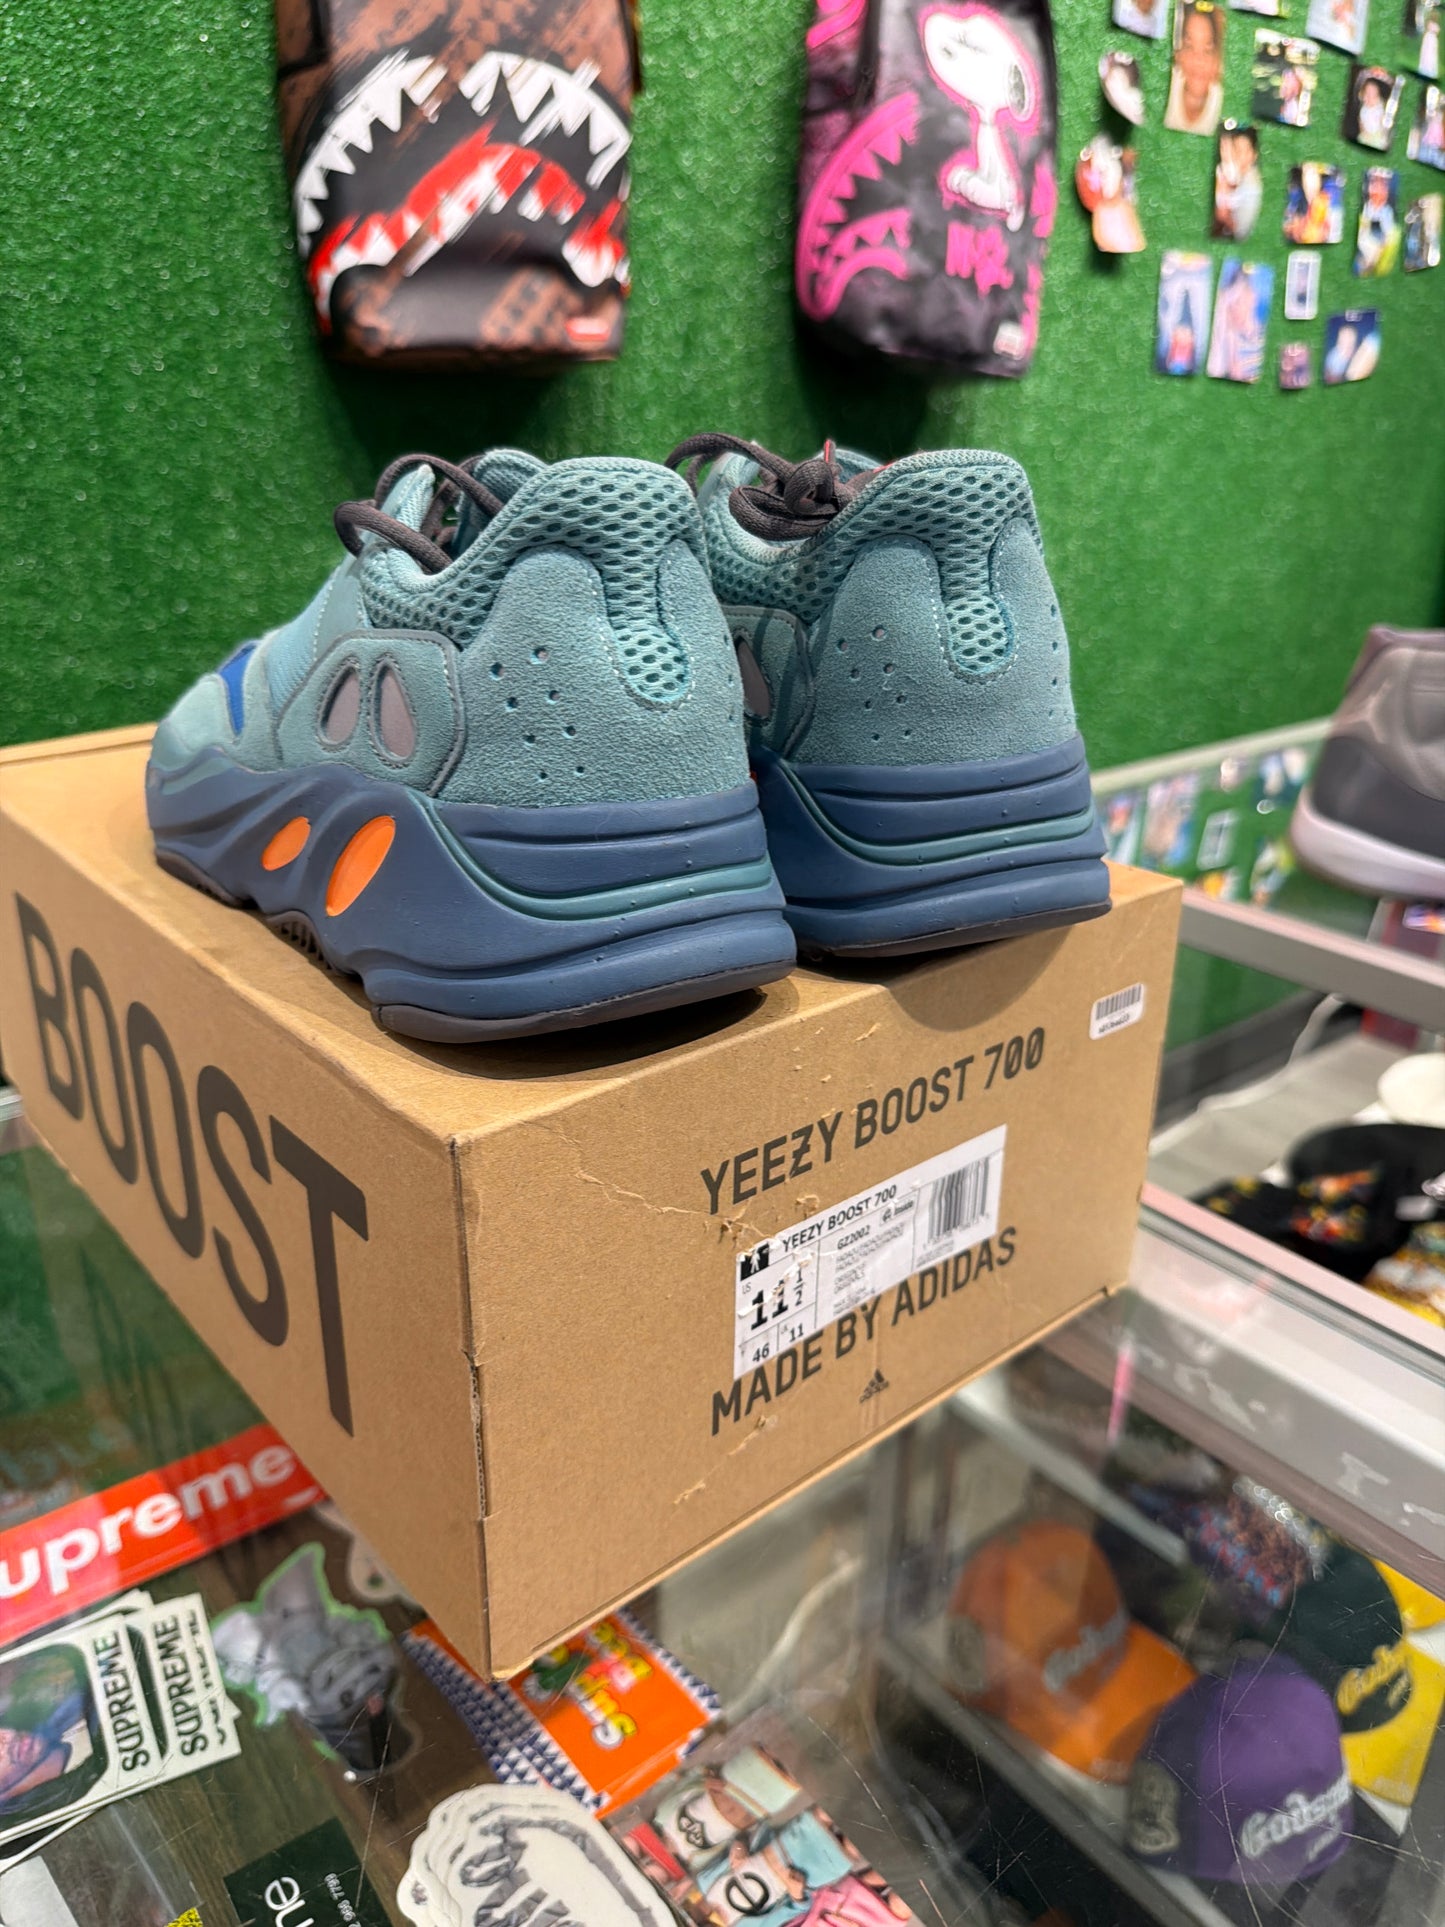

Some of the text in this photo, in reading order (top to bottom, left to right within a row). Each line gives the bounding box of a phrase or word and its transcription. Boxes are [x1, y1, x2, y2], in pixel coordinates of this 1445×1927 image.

[16, 890, 368, 1438] BOOST
[701, 1027, 1045, 1215] YEEZY BOOST 700
[783, 1220, 825, 1252] YEEZY
[828, 1197, 872, 1229] BOOST
[873, 1184, 898, 1207] 700
[837, 1225, 871, 1250] GZ2002
[711, 1331, 823, 1437] MADE
[836, 1295, 881, 1359] BY
[891, 1227, 1017, 1327] ADIDAS
[752, 1343, 770, 1363] 46
[789, 1322, 804, 1343] 11
[93, 1631, 150, 1772] SUPREME
[153, 1615, 209, 1756] SUPREME
